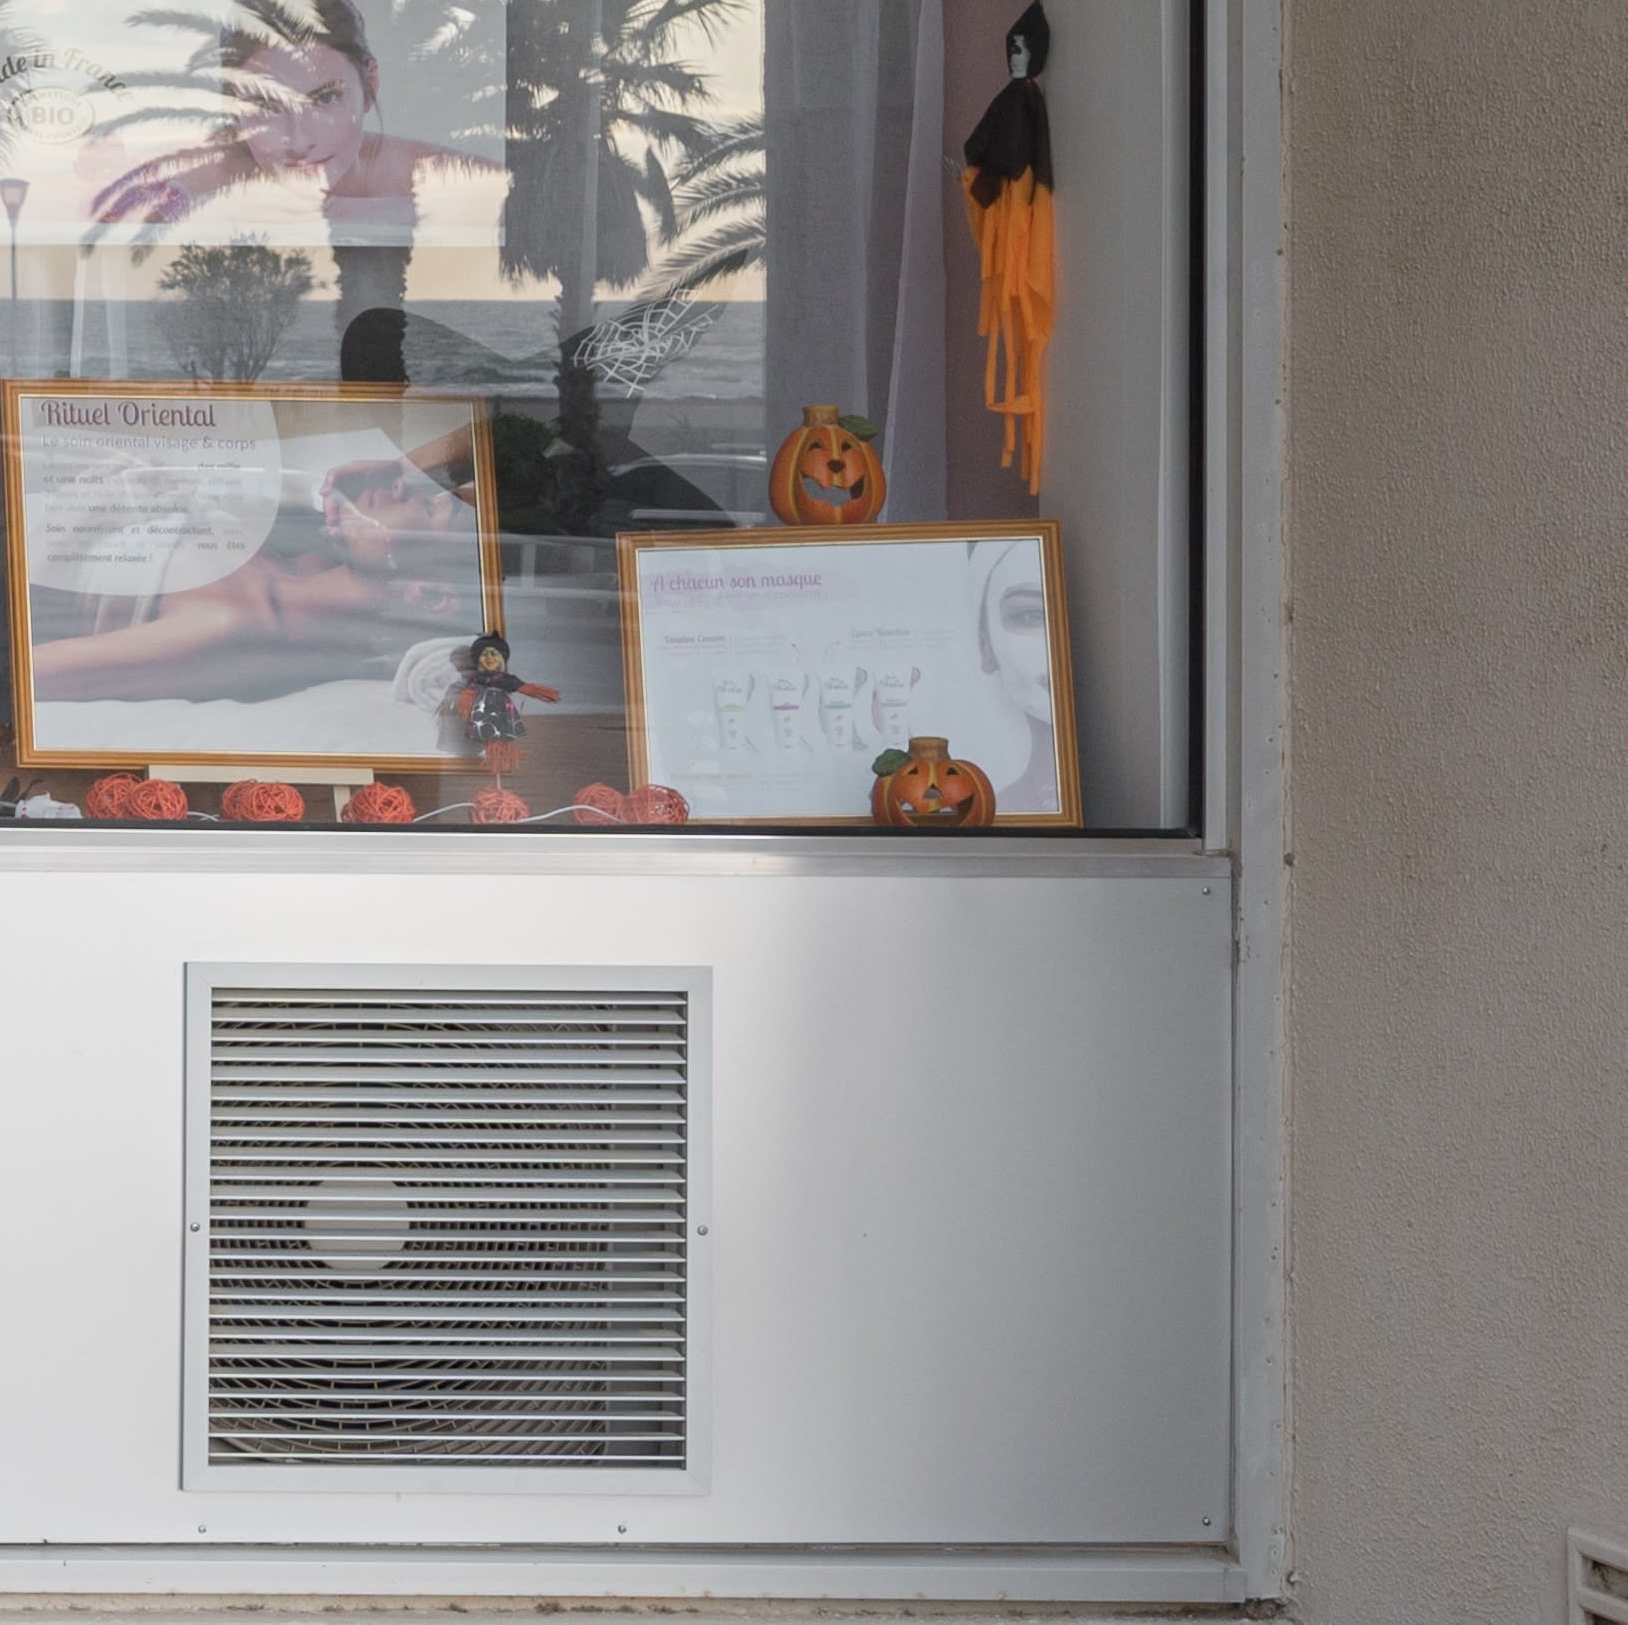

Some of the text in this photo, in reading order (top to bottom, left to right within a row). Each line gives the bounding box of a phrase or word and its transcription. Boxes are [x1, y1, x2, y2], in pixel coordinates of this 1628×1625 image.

[32, 48, 56, 69] in
[64, 47, 135, 103] France
[31, 106, 75, 125] BIO
[41, 399, 216, 427] Rituel Oriental
[95, 435, 150, 449] oriental
[152, 436, 198, 452] visage
[201, 436, 214, 450] &
[217, 438, 257, 453] corps
[46, 524, 67, 534] Soin
[669, 572, 725, 591] chacun
[729, 572, 757, 589] son
[760, 571, 823, 595] masque
